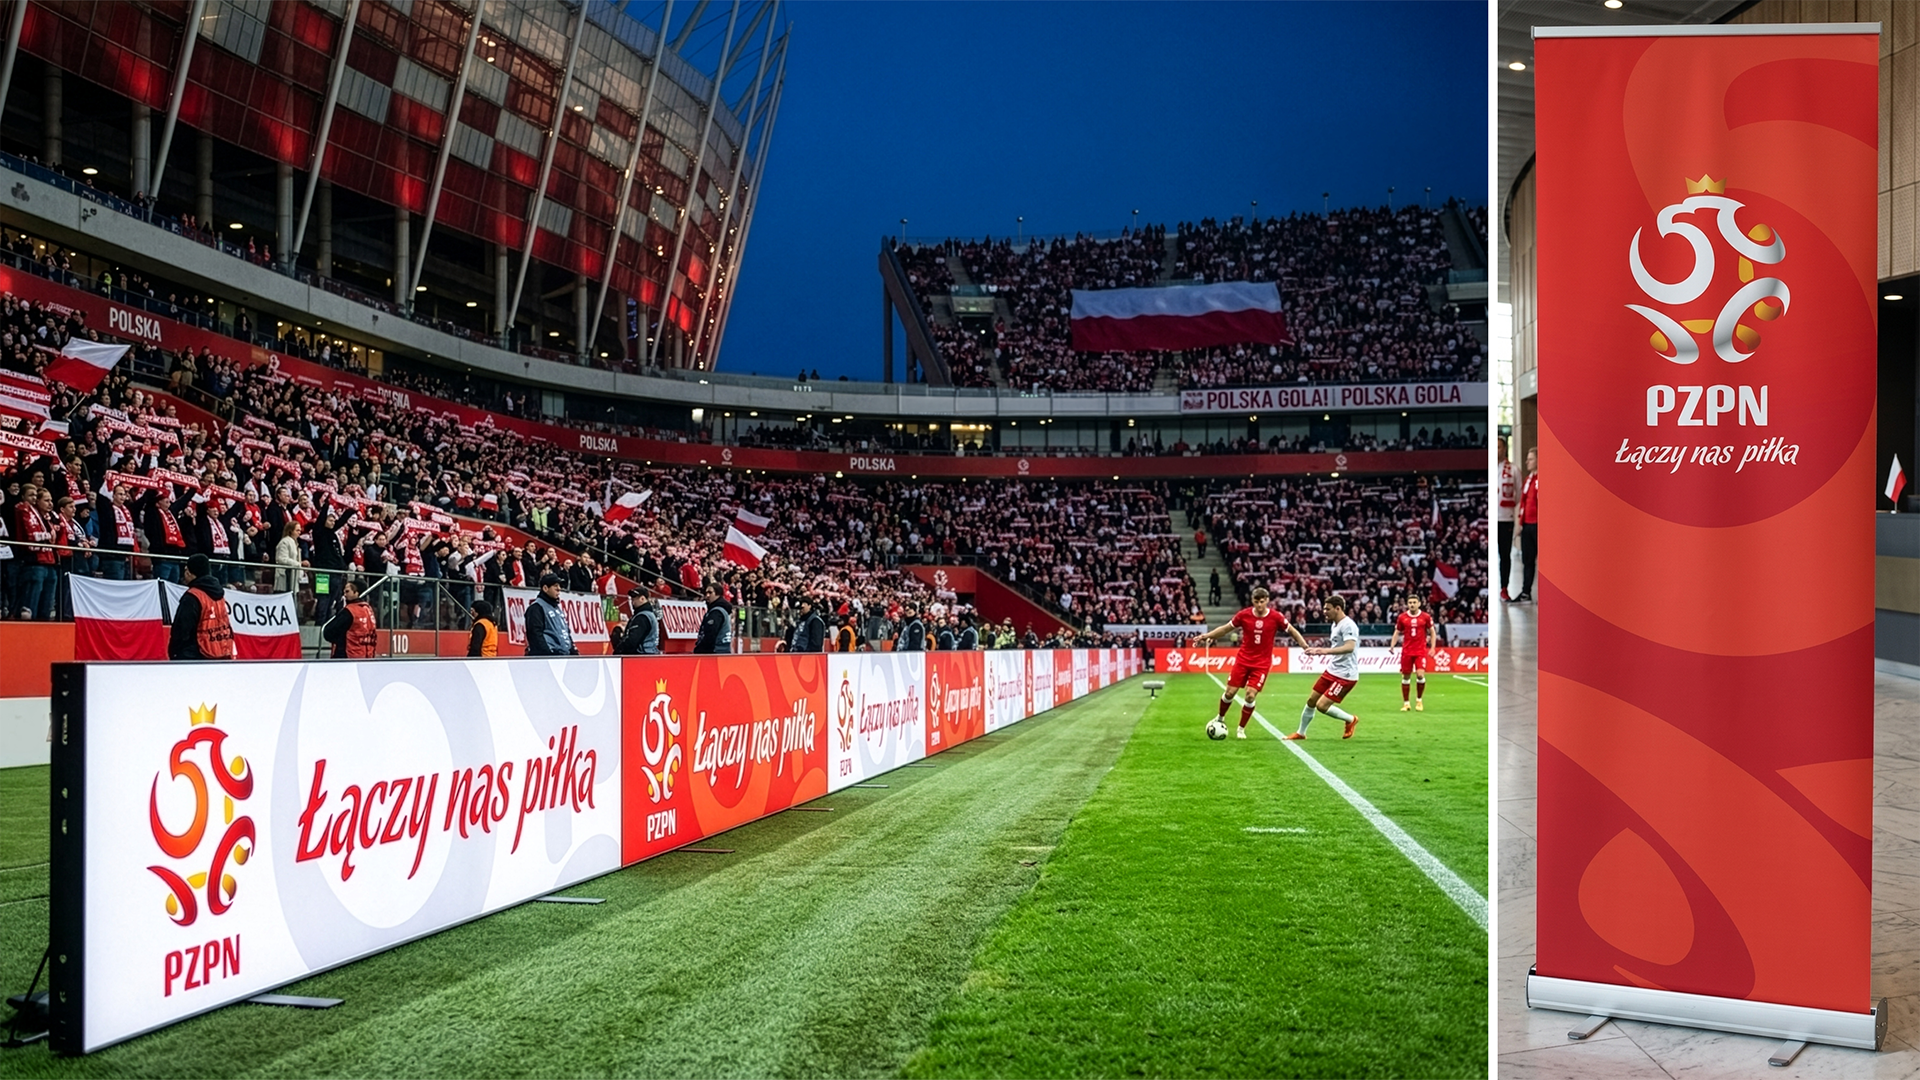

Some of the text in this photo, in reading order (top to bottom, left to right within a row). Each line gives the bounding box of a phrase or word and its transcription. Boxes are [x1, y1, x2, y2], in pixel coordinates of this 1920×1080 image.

[109, 307, 162, 342] POLSKA
[1207, 384, 1462, 410] POLSKA GOLA! POLSKA GOLA
[1646, 384, 1768, 426] PZPN
[579, 434, 618, 453] POLSKA
[1614, 437, 1800, 474] Łączy nas piłka
[850, 456, 896, 471] POLSKA
[693, 698, 815, 789] Łączy nas piłka
[296, 725, 597, 881] Łączy nas piłka
[646, 808, 676, 842] PZPN
[164, 933, 241, 998] PZPN
